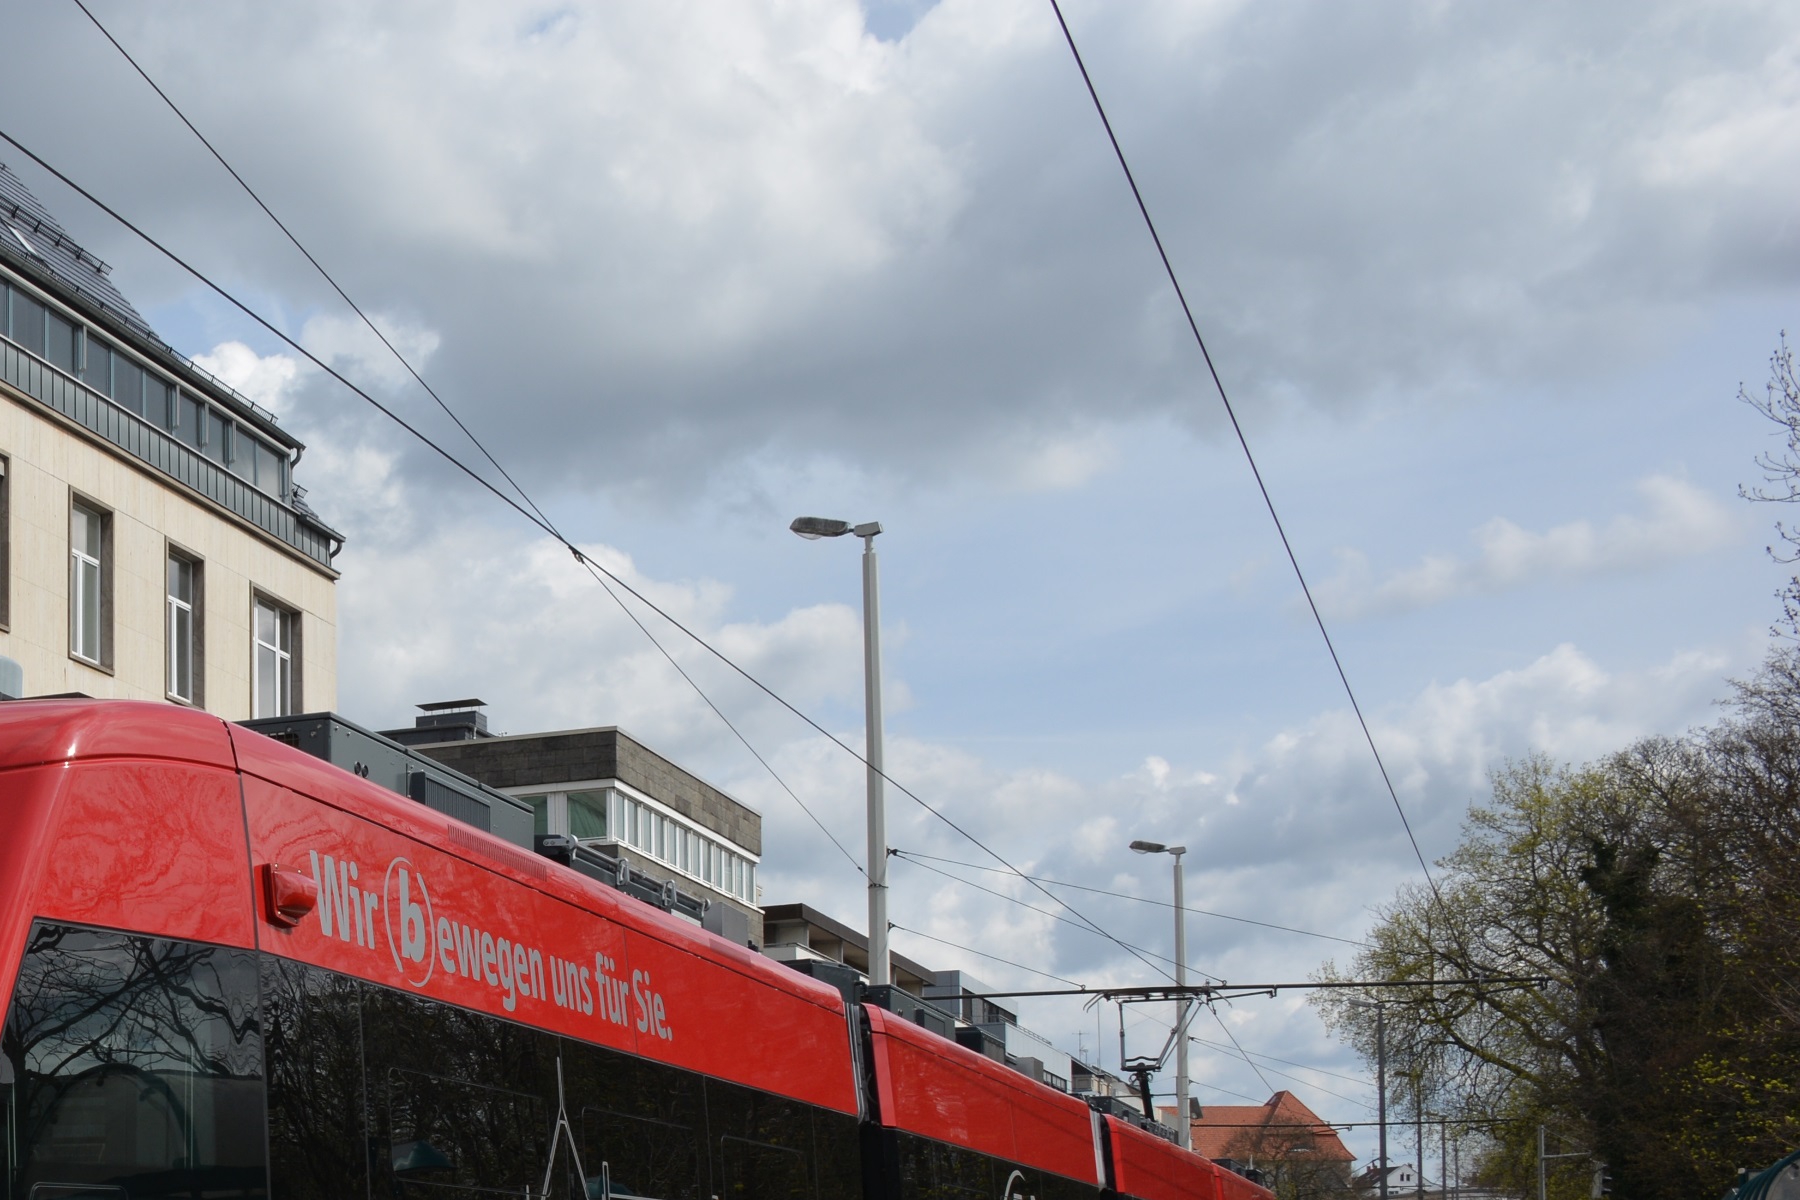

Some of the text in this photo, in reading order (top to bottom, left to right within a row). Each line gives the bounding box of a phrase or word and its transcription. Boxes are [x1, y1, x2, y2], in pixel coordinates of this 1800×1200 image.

[310, 850, 378, 950] Wir
[549, 955, 595, 1016] uns
[595, 951, 630, 1027] für
[632, 968, 674, 1042] Sie.
